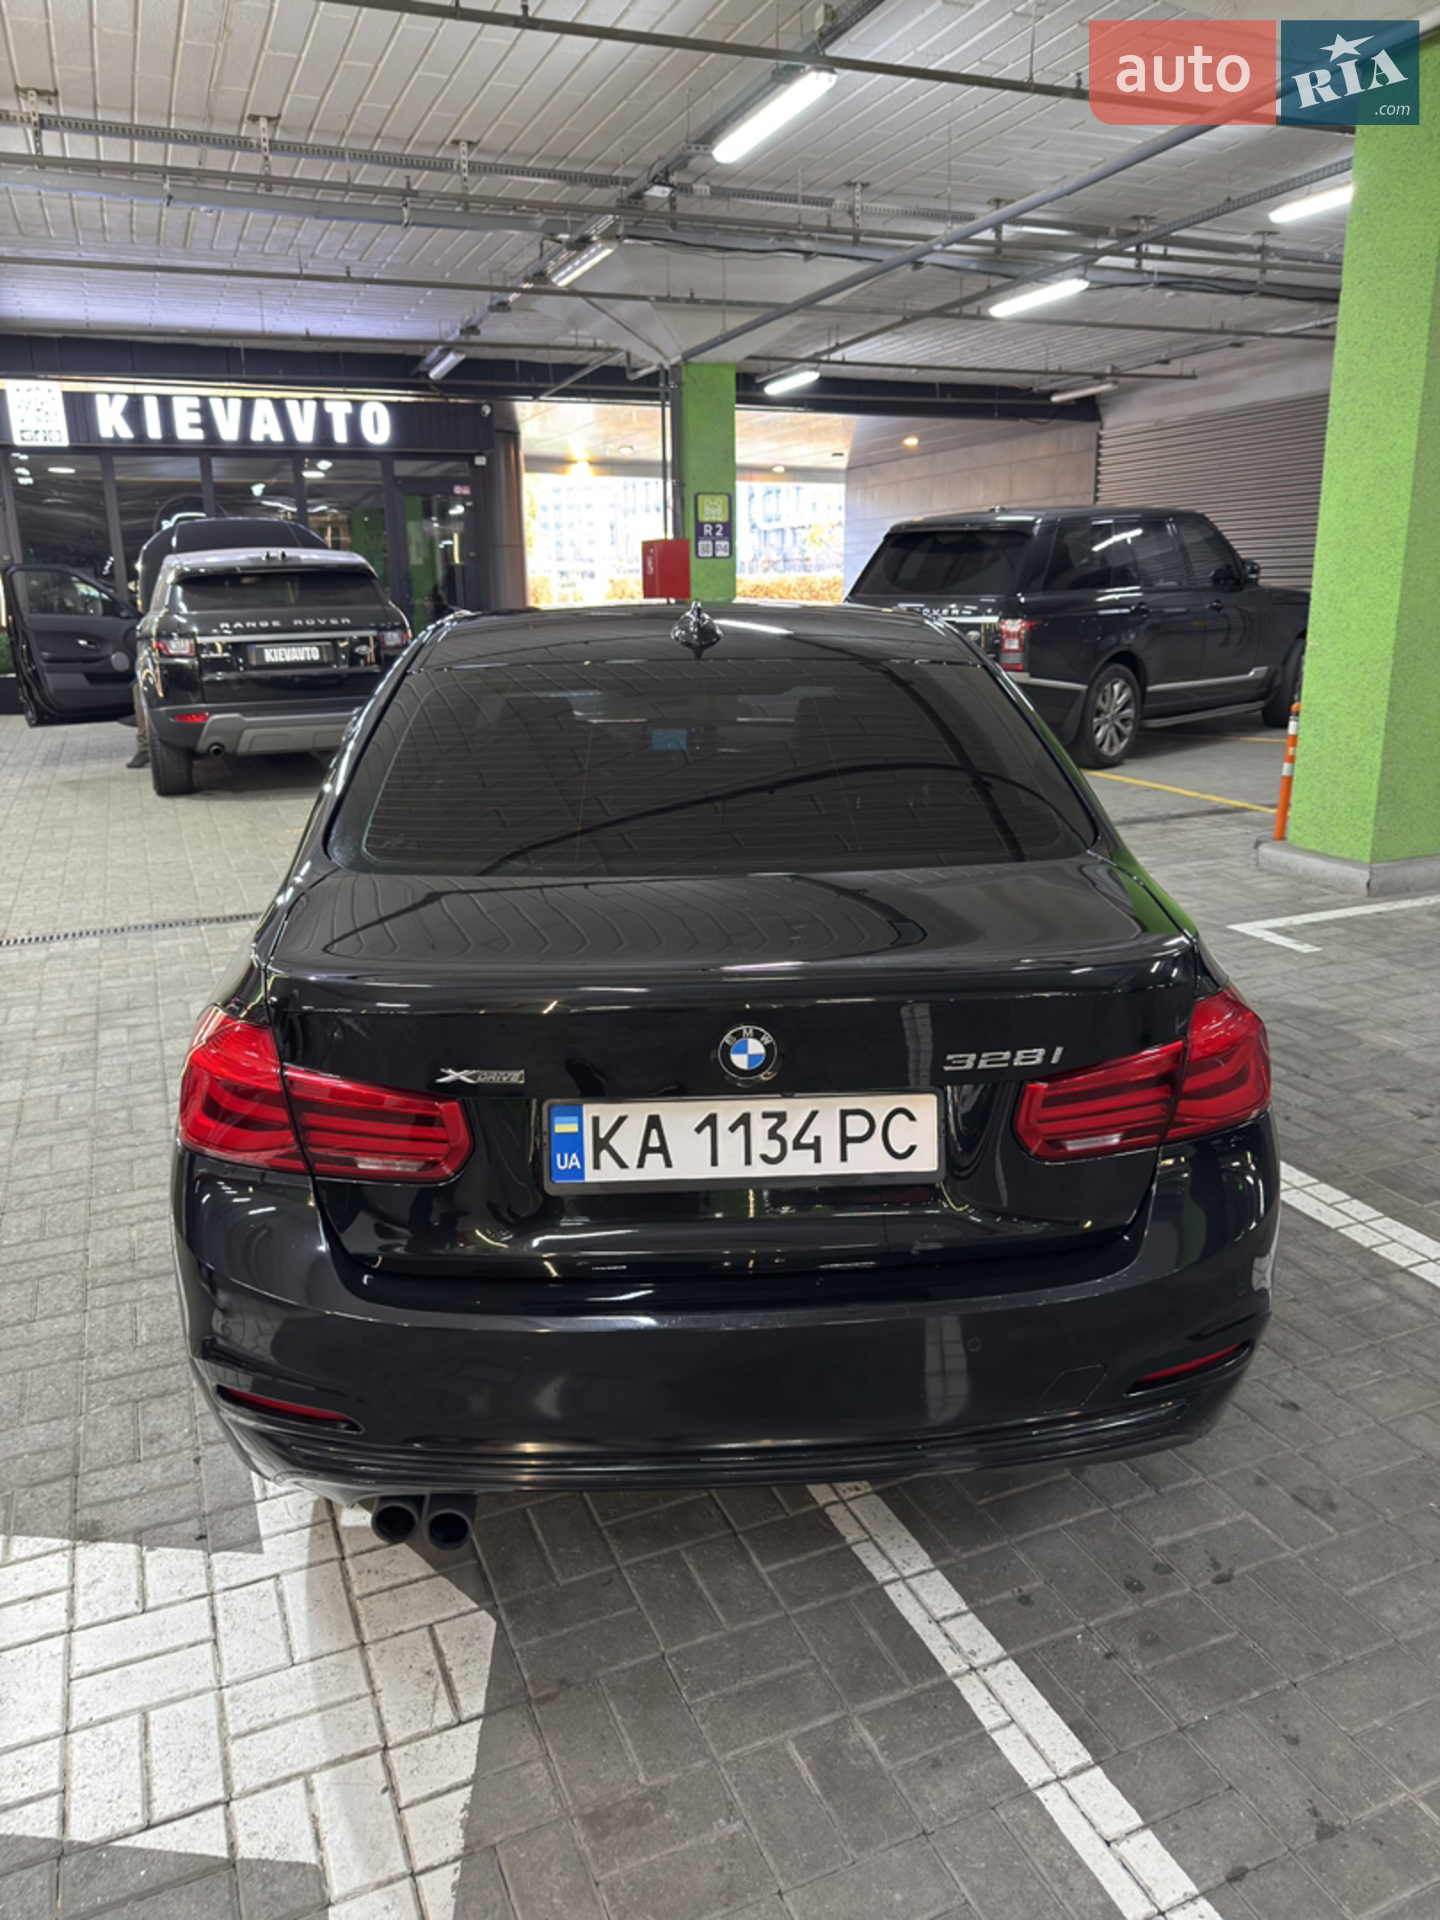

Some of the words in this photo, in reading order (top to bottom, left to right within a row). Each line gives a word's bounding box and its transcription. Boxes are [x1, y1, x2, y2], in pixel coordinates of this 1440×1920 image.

[95, 393, 392, 445] KIEVAVTO
[219, 620, 282, 629] RANGE
[293, 618, 352, 626] ROVER
[263, 646, 321, 662] KIEVAVTO
[591, 1114, 674, 1171] KA
[694, 1109, 822, 1168] 1134
[839, 1107, 918, 1163] PC
[556, 1153, 582, 1170] UA
